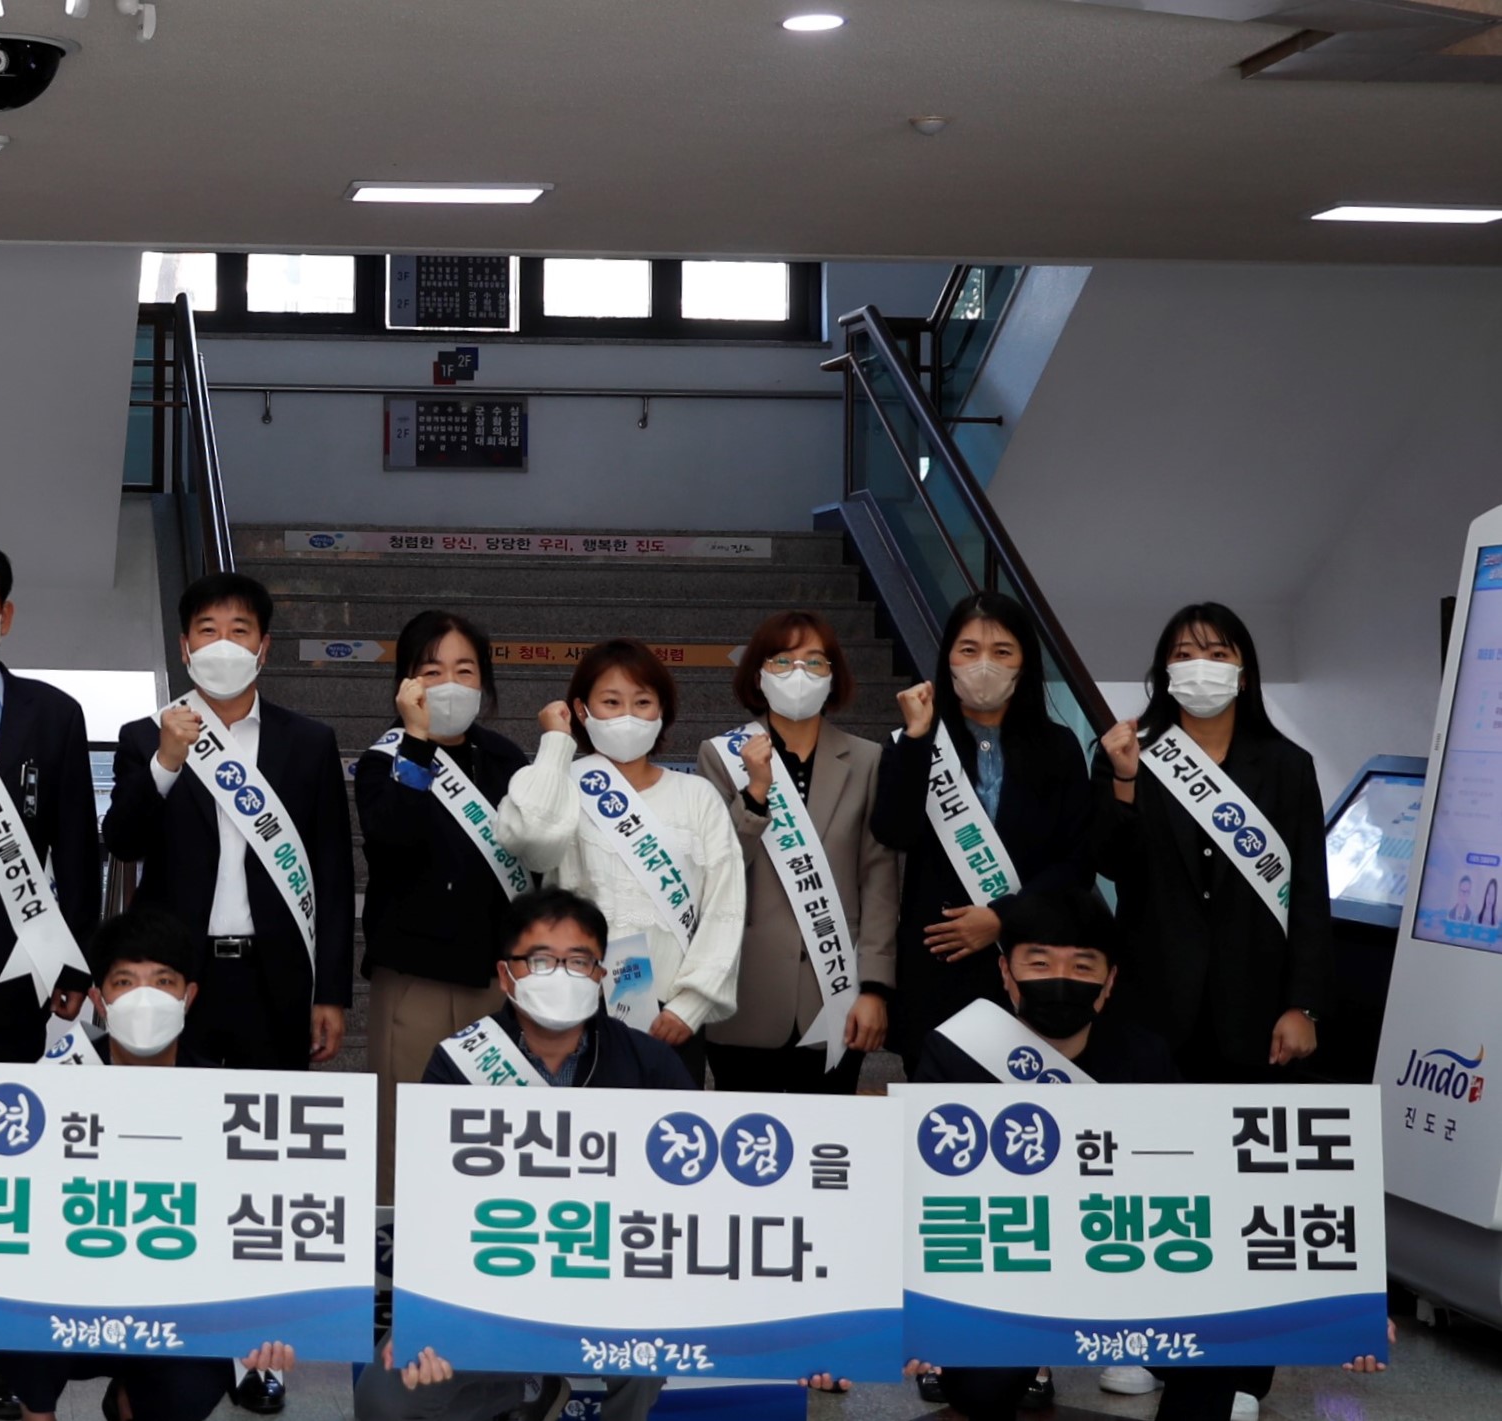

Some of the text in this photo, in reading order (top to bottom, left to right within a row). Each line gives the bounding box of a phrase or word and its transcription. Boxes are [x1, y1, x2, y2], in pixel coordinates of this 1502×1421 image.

[441, 364, 454, 377] 1F
[458, 355, 472, 367] 2F
[397, 428, 410, 439] 2F
[389, 535, 665, 552] 청렴한 당신, 당당한 우리, 행복한 진도
[519, 645, 556, 660] 청탁,
[929, 769, 970, 822] 진도
[1149, 737, 1222, 803] 당신의
[632, 833, 690, 909] 공직사회
[786, 853, 824, 893] 함께
[804, 896, 852, 996] 만들어가요
[1397, 1049, 1469, 1099] Jindo
[223, 1093, 347, 1160] 진도
[449, 1108, 617, 1178] 당신의
[1232, 1106, 1355, 1173] 진도
[1405, 1107, 1456, 1141] 진도군
[61, 1177, 197, 1260] 행정
[227, 1193, 346, 1262] 실현
[470, 1197, 828, 1282] 응원합니다.
[919, 1193, 1357, 1274] 클린 행정 실현
